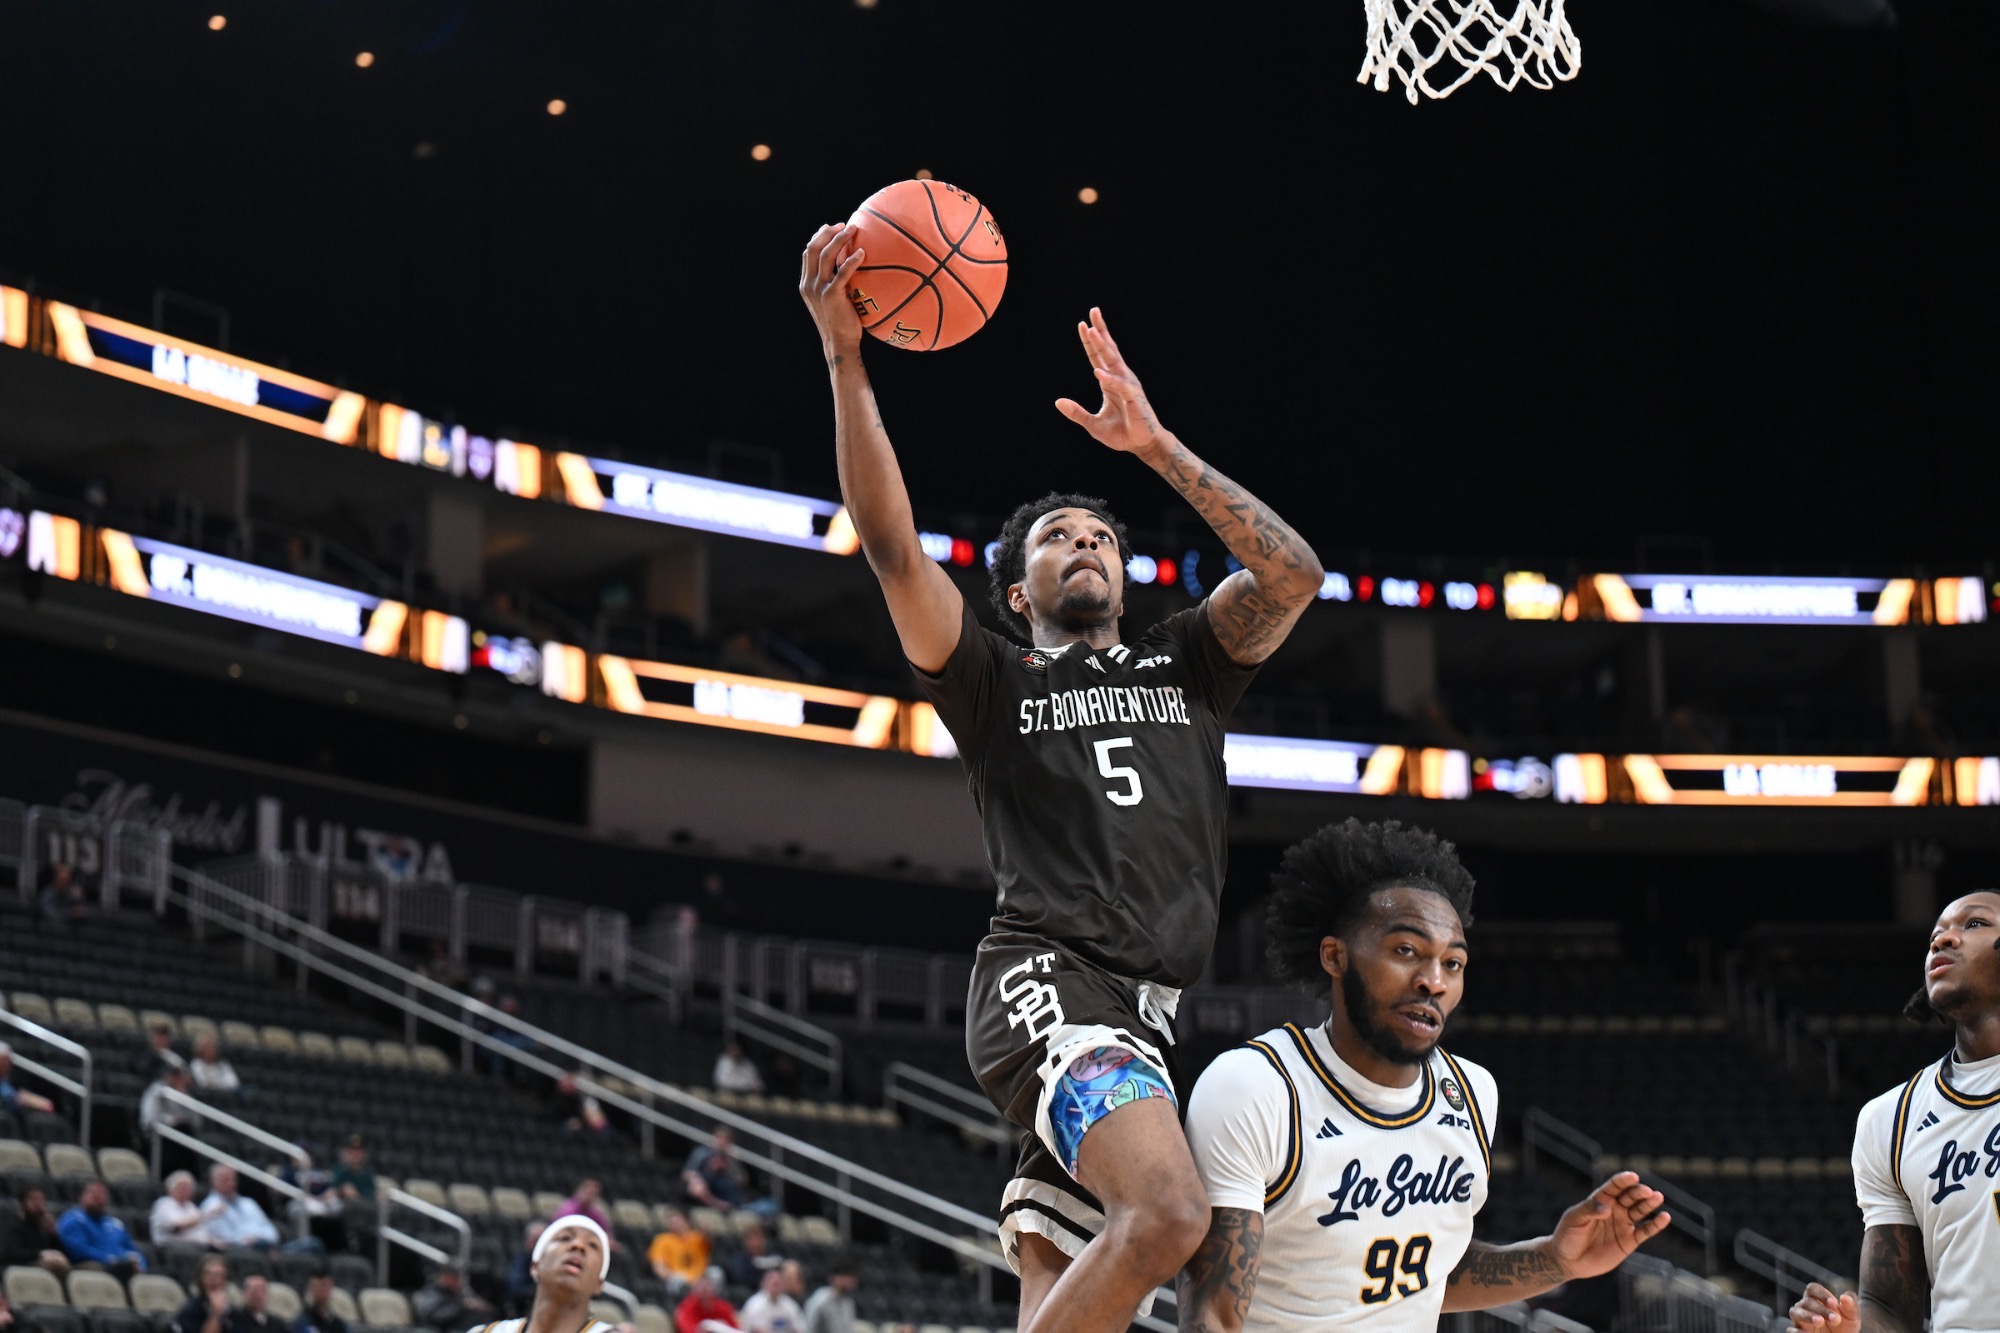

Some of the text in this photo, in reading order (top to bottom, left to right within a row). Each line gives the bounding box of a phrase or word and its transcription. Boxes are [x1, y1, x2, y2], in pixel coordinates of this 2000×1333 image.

[1019, 686, 1191, 735] ST. BONAVENTURE
[1093, 737, 1144, 807] 5
[1317, 1154, 1475, 1227] La Salle
[1929, 1139, 1980, 1205] La
[1358, 1233, 1432, 1306] 99
